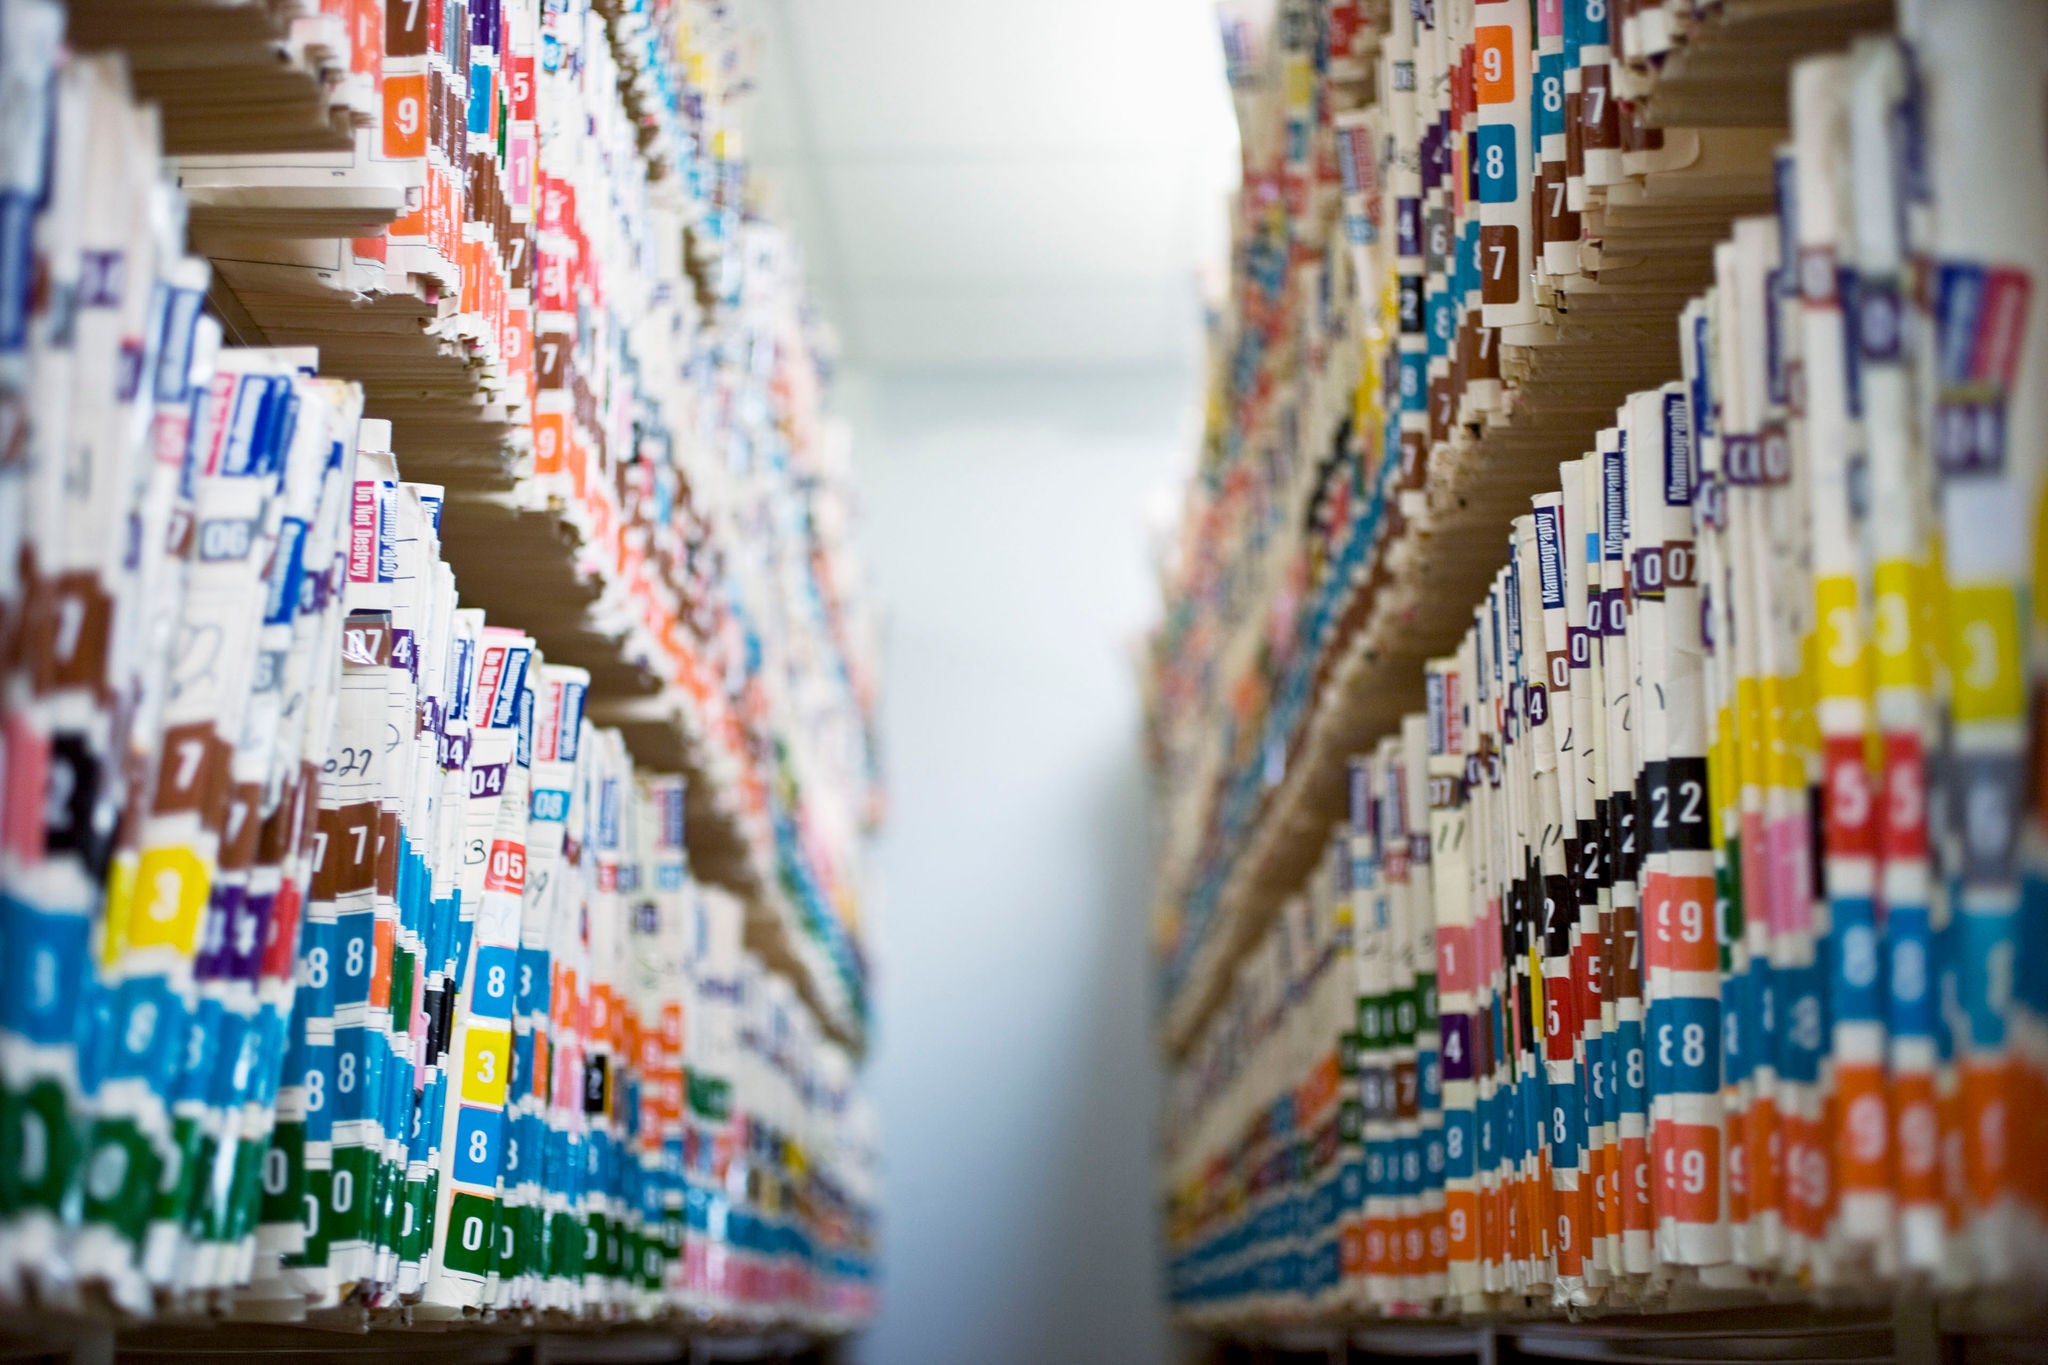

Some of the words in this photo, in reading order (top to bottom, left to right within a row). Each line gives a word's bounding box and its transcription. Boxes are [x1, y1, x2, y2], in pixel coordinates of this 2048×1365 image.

[1483, 47, 1502, 82] 9
[513, 72, 529, 102] 5
[1542, 77, 1562, 112] 8
[1587, 87, 1606, 123] 7
[397, 97, 419, 135] 9
[515, 156, 526, 187] 1
[1486, 144, 1504, 180] 8
[1547, 182, 1565, 218] 7
[509, 238, 525, 269] 7
[1430, 228, 1445, 255] 6
[1488, 246, 1507, 280] 7
[505, 326, 521, 358] 9
[541, 344, 558, 375] 7
[1475, 328, 1492, 358] 7
[538, 427, 557, 459] 9
[1668, 400, 1689, 501] Mammography
[355, 485, 371, 503] Do
[1604, 457, 1622, 555] Mammography
[354, 505, 372, 527] Not
[350, 528, 372, 578] Destroy
[1535, 512, 1561, 604] Mammography
[392, 635, 411, 662] 4
[494, 650, 527, 725] Mammography
[1530, 692, 1543, 720] 4
[470, 769, 501, 796] 04
[1679, 780, 1702, 824] 2
[349, 825, 368, 865] 7
[1584, 841, 1599, 880] 2
[493, 852, 524, 879] 05
[1544, 897, 1556, 933] 2
[1679, 900, 1703, 943] 9
[308, 946, 329, 989] 8
[345, 937, 364, 977] 8
[1443, 943, 1455, 975] 1
[1624, 930, 1639, 970] 7
[487, 965, 506, 998] 8
[1547, 999, 1560, 1036] 5
[1444, 1032, 1463, 1065] 4
[1682, 1023, 1705, 1067] 8
[337, 1052, 356, 1094] 8
[477, 1050, 496, 1083] 3
[1627, 1048, 1645, 1089] 8
[304, 1069, 325, 1112] 8
[1448, 1126, 1464, 1159] 8
[1553, 1106, 1567, 1144] 8
[468, 1129, 488, 1164] 8
[264, 1148, 288, 1195] 0
[1681, 1149, 1706, 1194] 9
[332, 1170, 353, 1213] 0
[462, 1216, 484, 1251] 0
[1450, 1210, 1467, 1242] 9
[1558, 1215, 1571, 1251] 9
